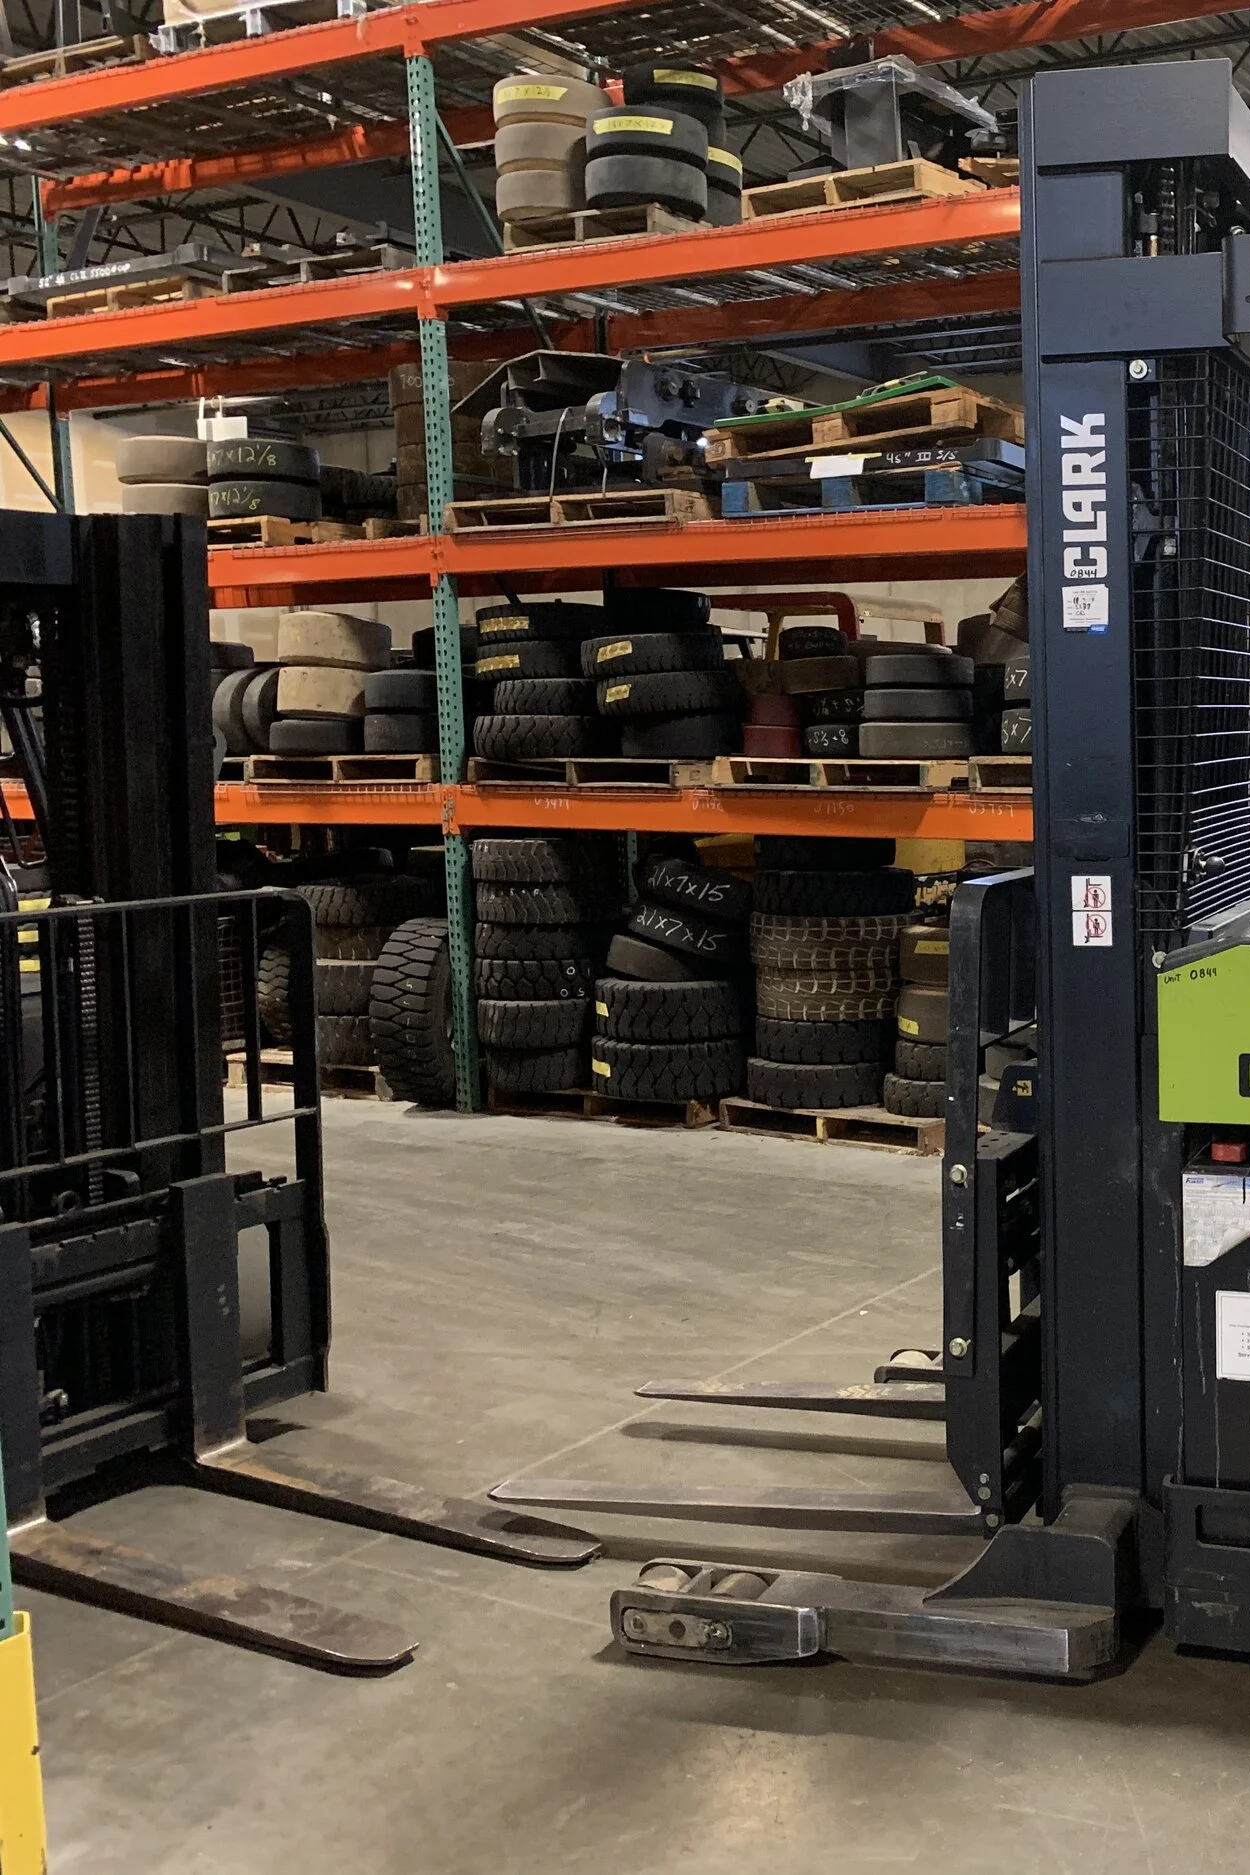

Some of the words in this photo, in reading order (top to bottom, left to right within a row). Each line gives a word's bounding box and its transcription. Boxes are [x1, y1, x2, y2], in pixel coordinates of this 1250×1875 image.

[1060, 413, 1109, 579] CLARK
[1070, 568, 1098, 578] 0844
[1189, 967, 1218, 980] 0844
